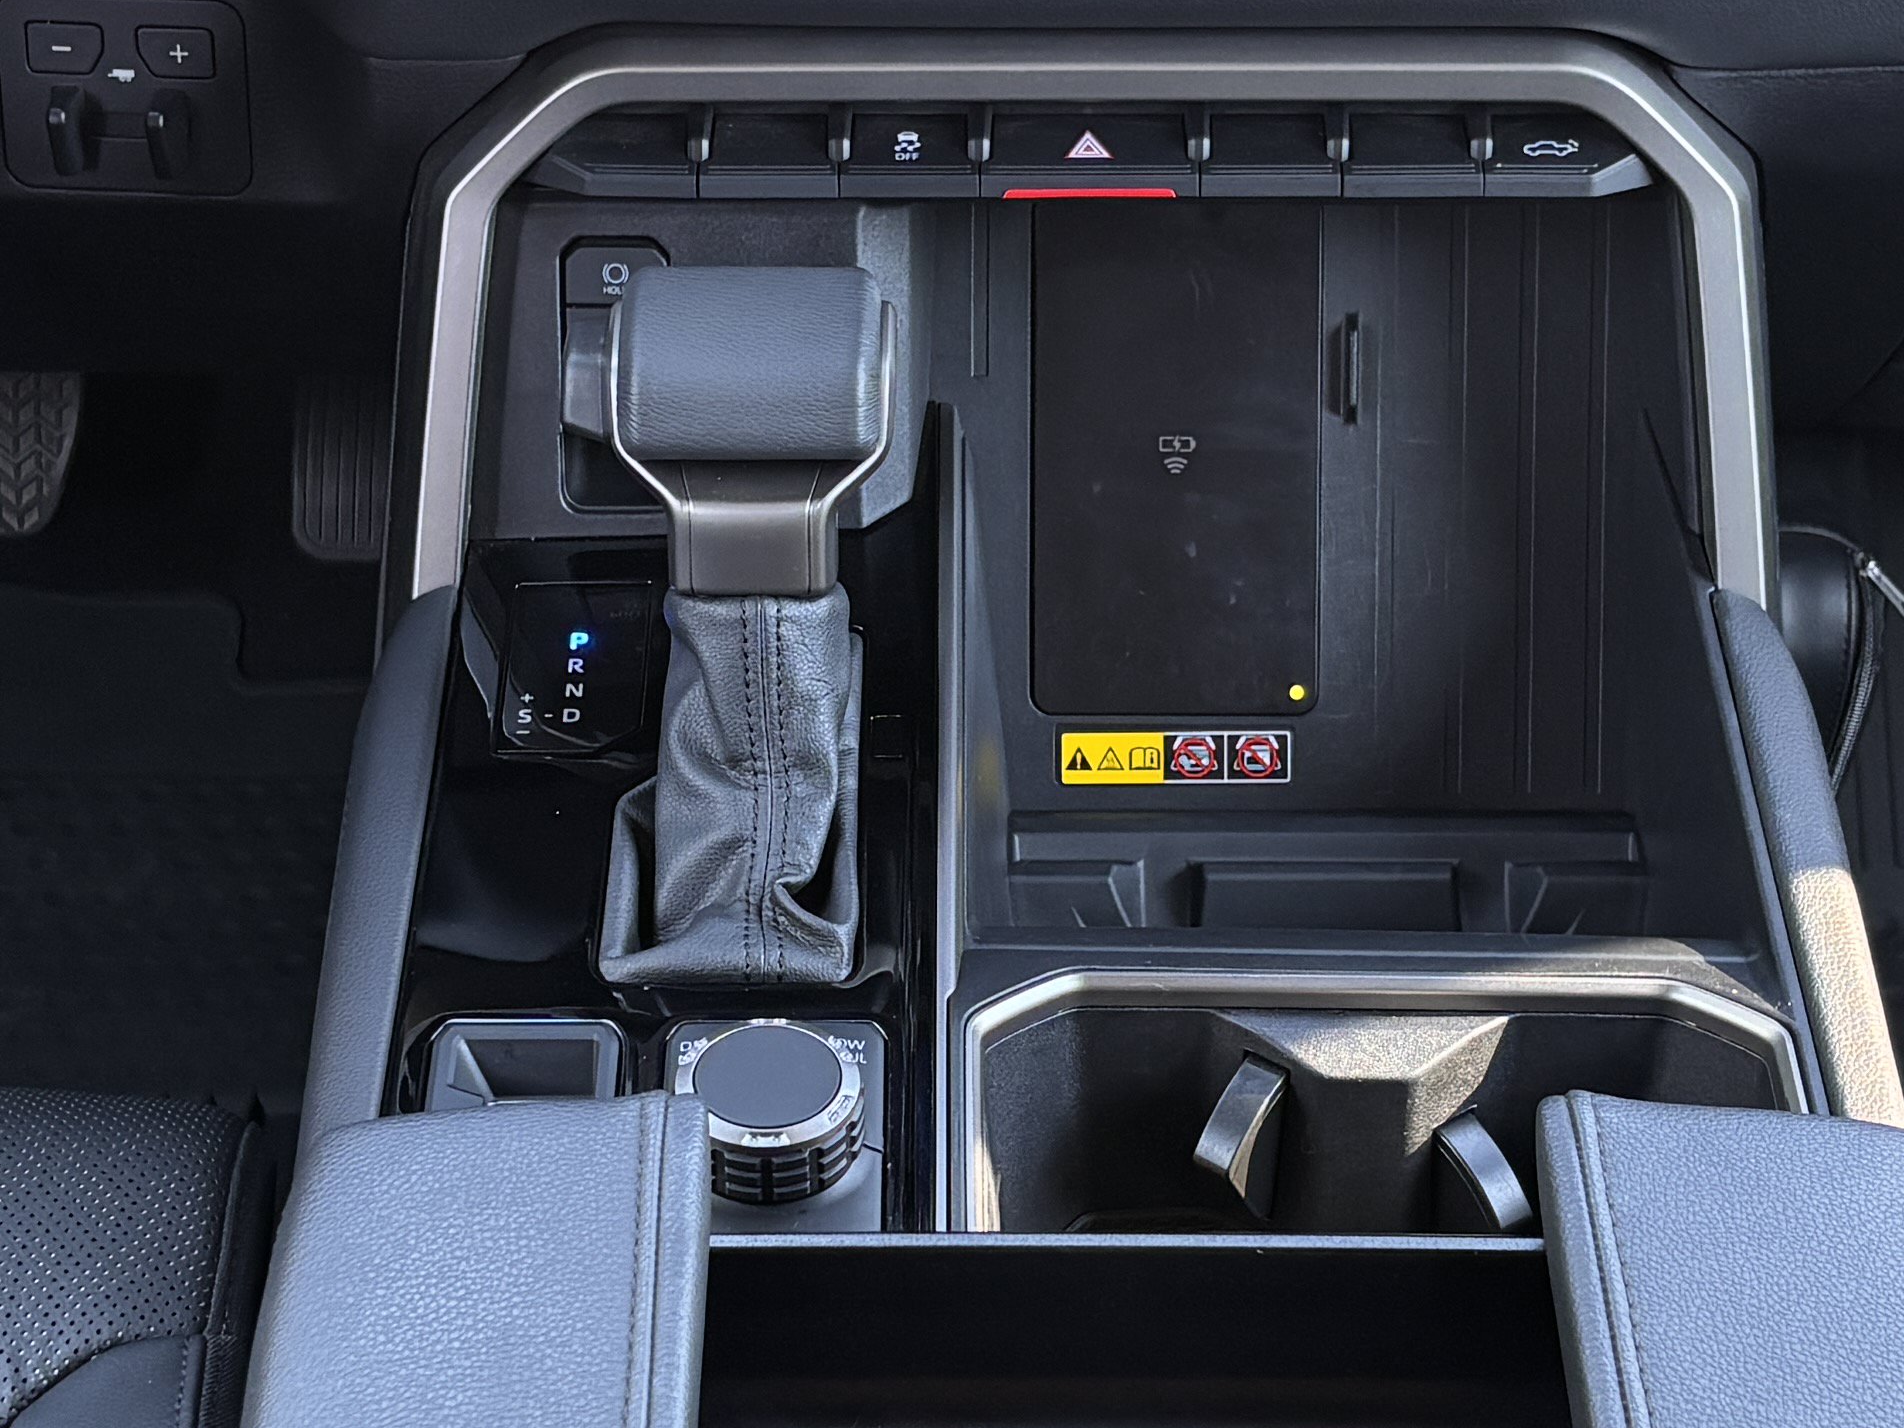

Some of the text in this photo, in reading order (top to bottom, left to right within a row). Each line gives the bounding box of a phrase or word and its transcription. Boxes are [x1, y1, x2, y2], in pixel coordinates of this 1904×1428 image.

[894, 152, 920, 161] OFF
[569, 631, 589, 651] P
[567, 658, 584, 674] R
[565, 683, 584, 698] N
[517, 708, 532, 724] S
[562, 708, 581, 723] D
